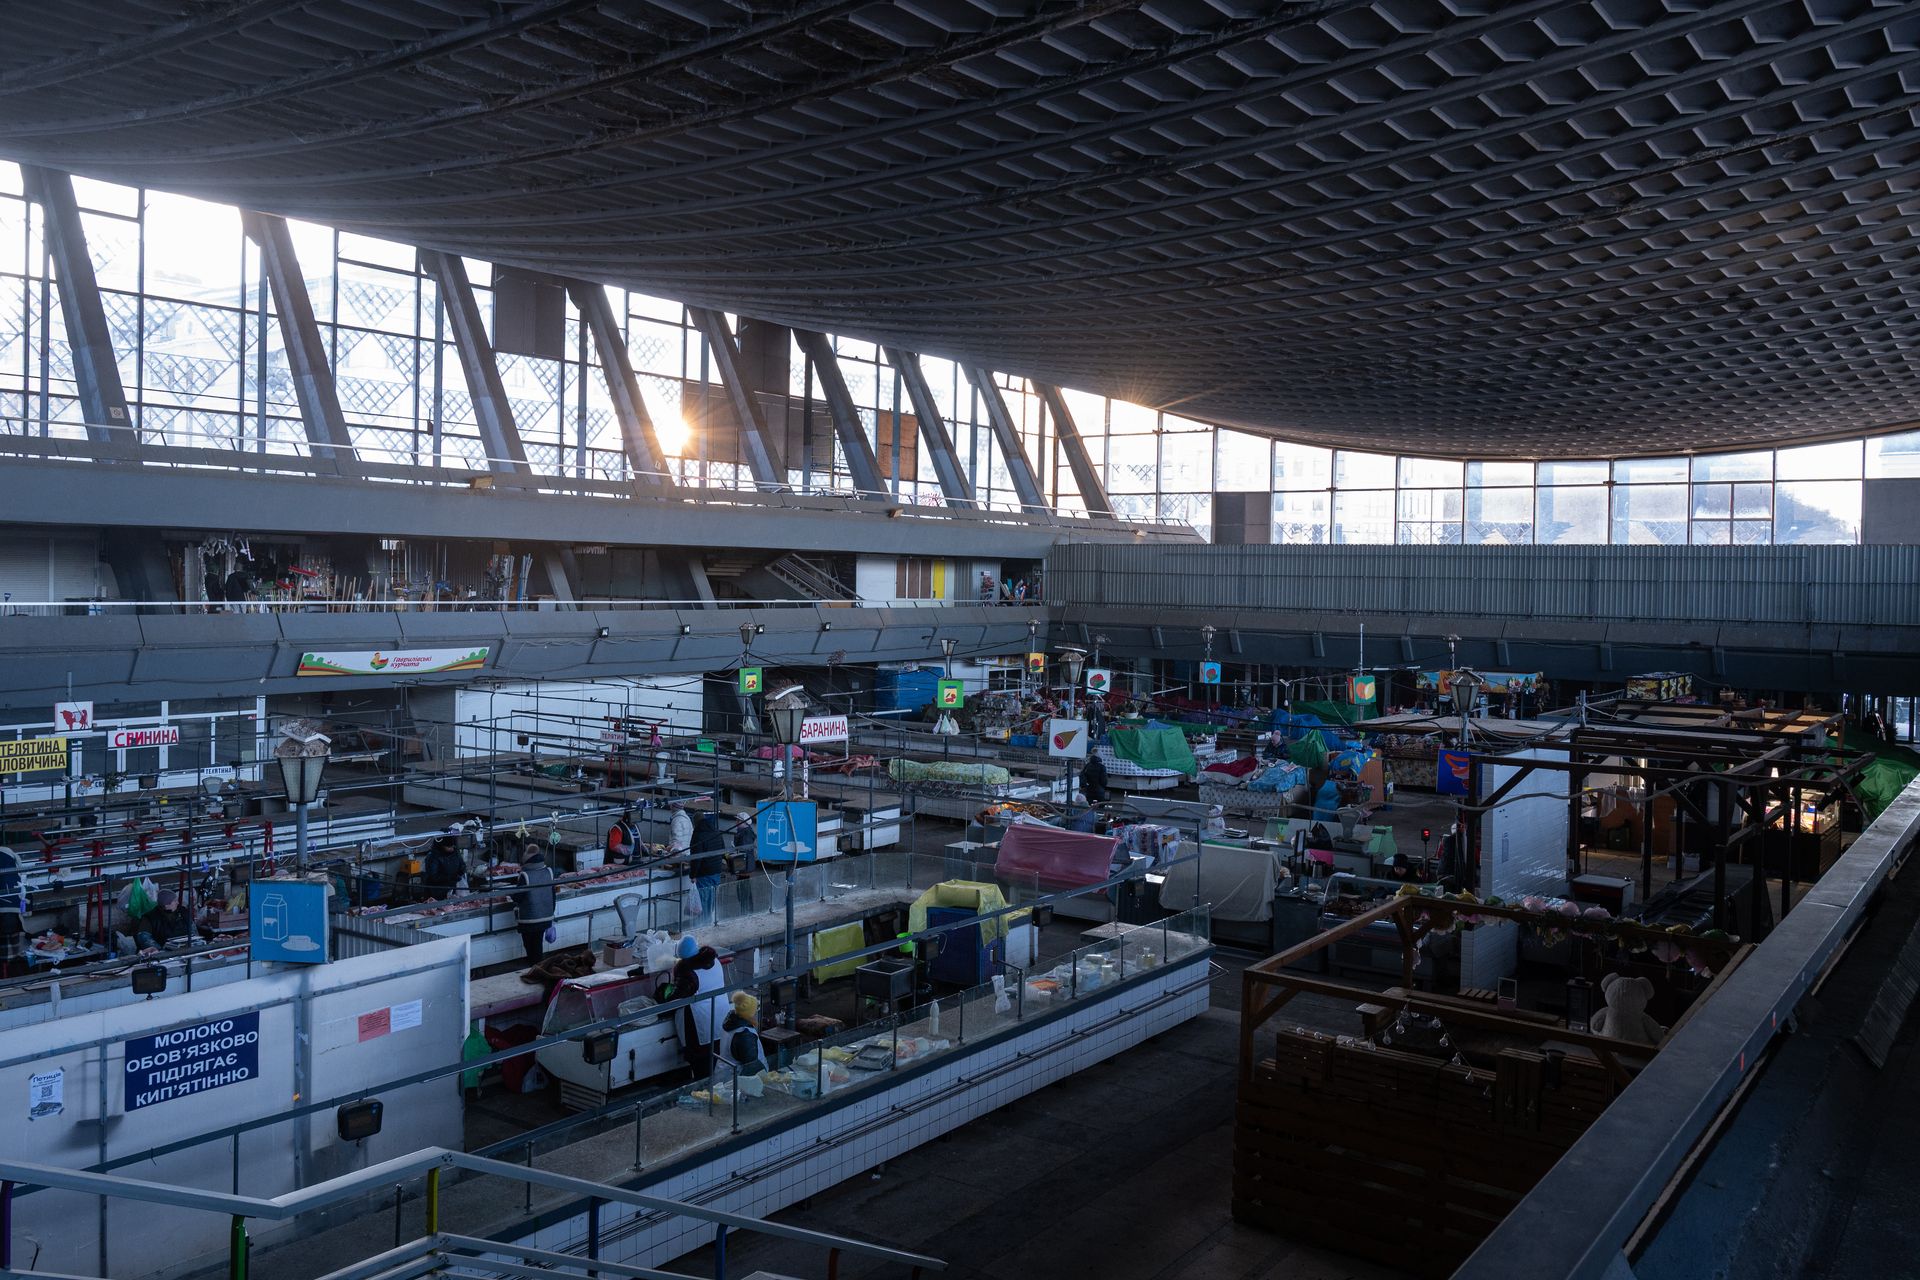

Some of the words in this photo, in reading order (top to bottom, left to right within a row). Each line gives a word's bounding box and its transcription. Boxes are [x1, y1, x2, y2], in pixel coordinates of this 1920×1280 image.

[801, 720, 847, 739] БАРАНИНА
[0, 740, 60, 757] ТЕЛЯТИНА
[0, 754, 66, 772] ЛОВИЧИНА
[154, 1019, 234, 1049] МОЛОКО
[126, 1031, 258, 1073] ОБОВ’ЯЗКОВО
[148, 1052, 238, 1086] ПІДЛЯГАЄ
[135, 1067, 250, 1107] КИП’ЯТІННЮ
